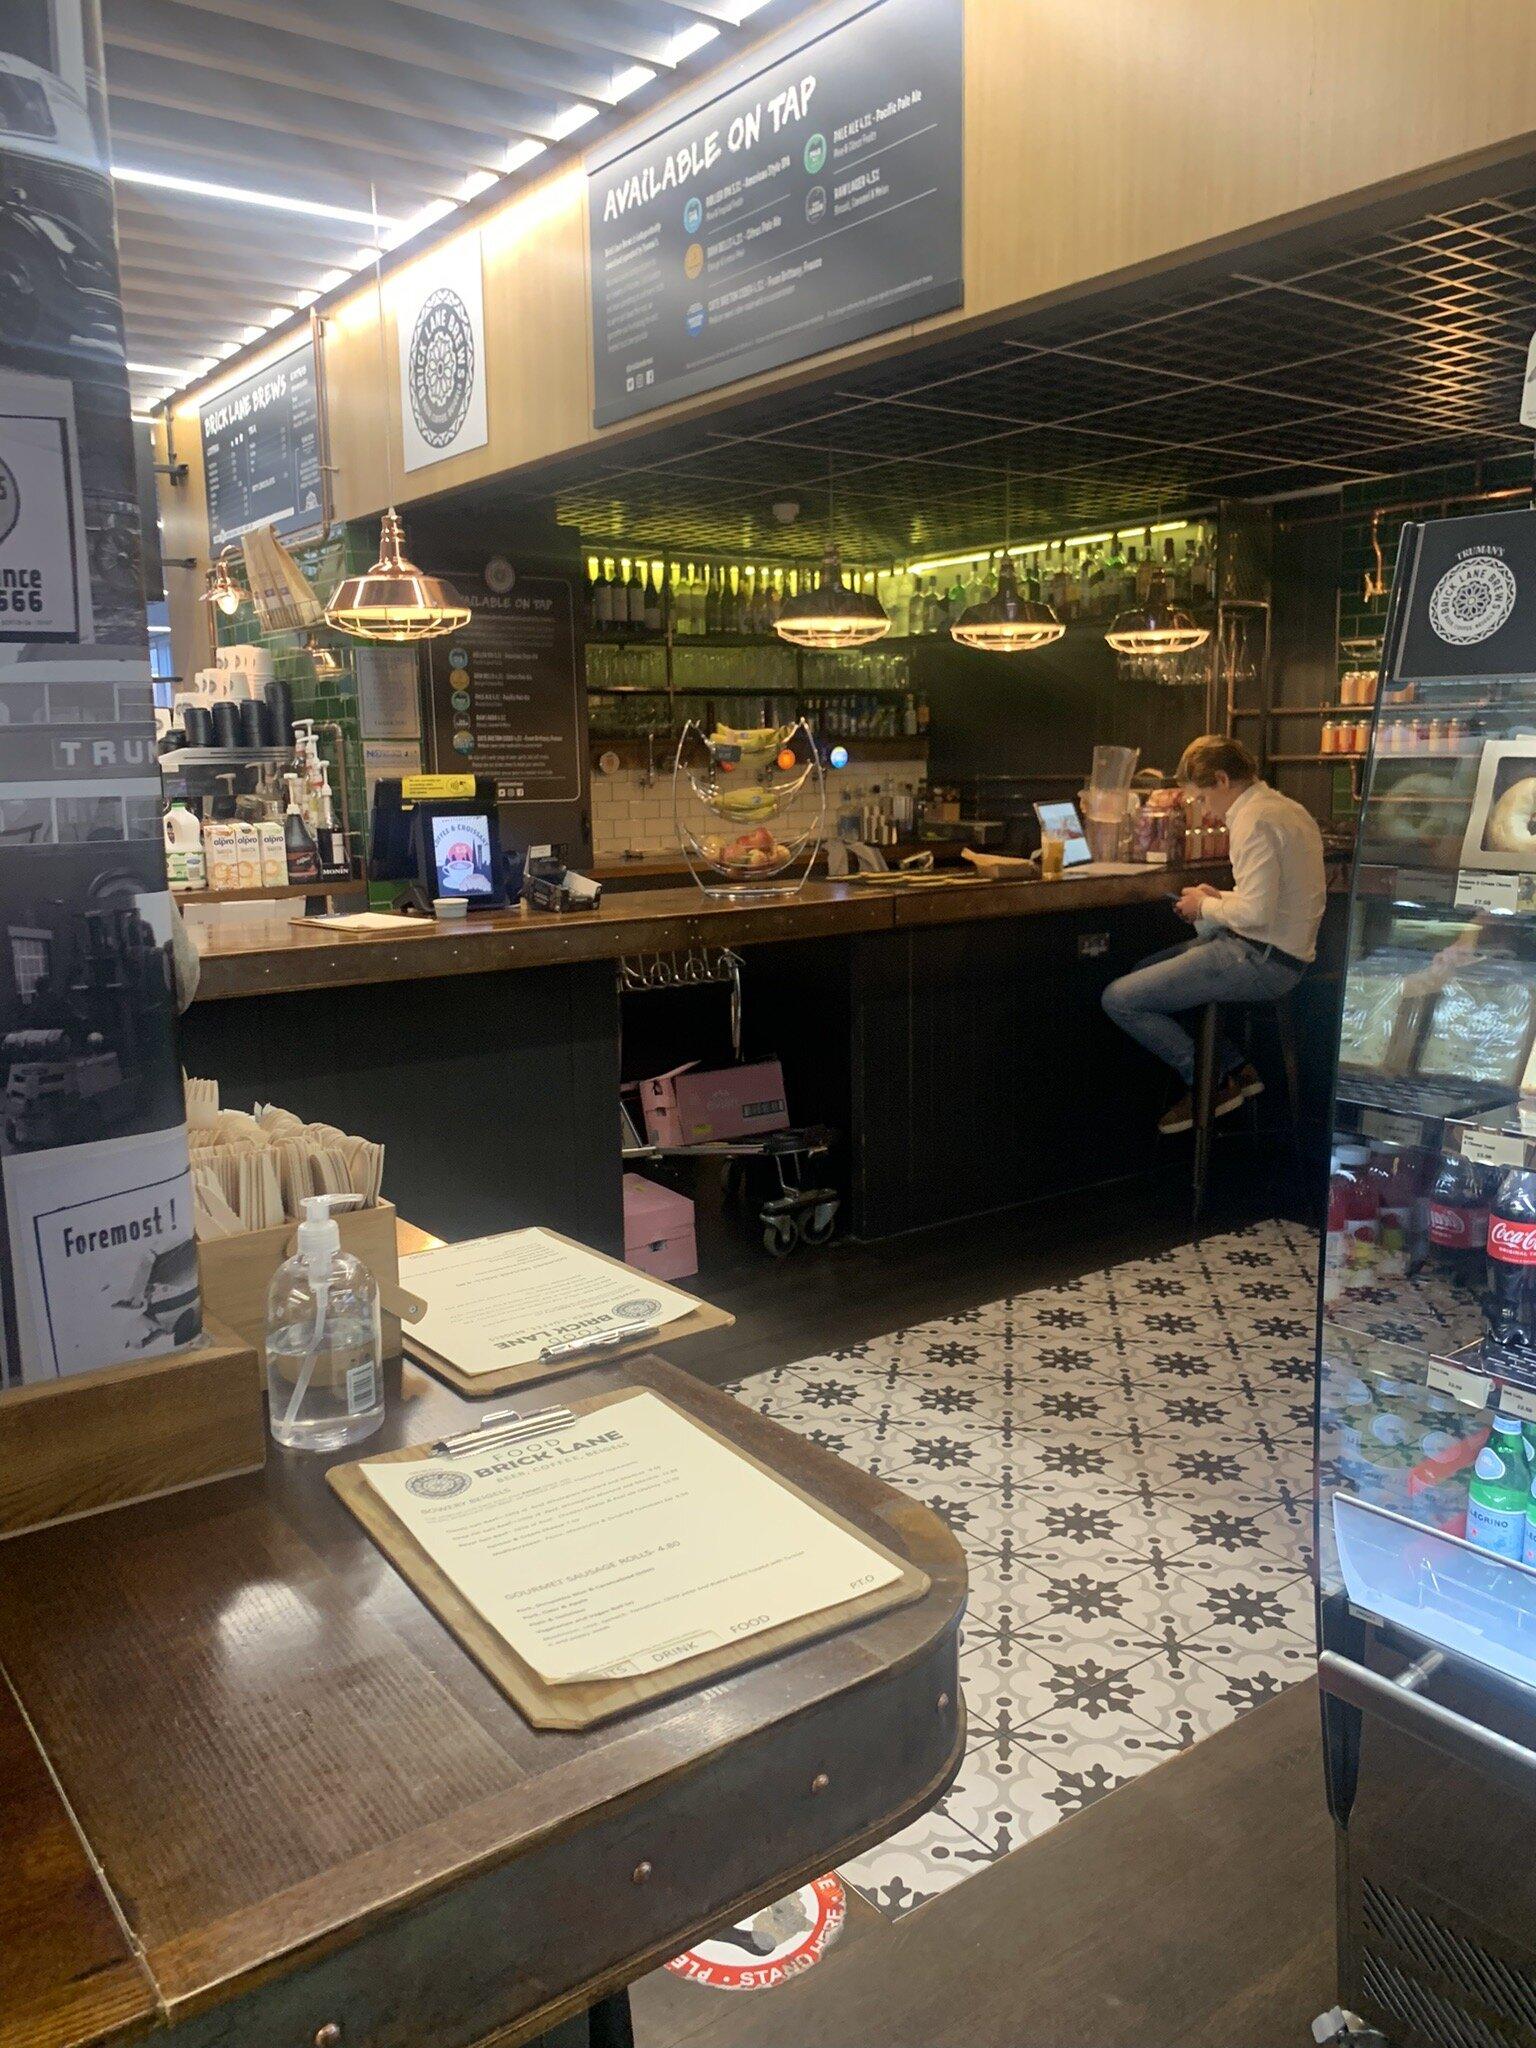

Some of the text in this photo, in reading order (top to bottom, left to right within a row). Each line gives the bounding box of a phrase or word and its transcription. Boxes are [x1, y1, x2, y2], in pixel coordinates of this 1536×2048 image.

[603, 130, 722, 223] AVAILABLE
[727, 105, 761, 154] ON
[768, 76, 817, 134] TAP
[415, 309, 466, 400] BRICK LANE BREWS
[203, 405, 228, 438] BRICK
[228, 391, 252, 423] LANE
[251, 374, 287, 412] BREWS
[1441, 569, 1504, 615] BRICK LANE BREWS
[213, 836, 235, 847] alpro
[237, 835, 258, 846] alpro
[263, 834, 284, 845] alpro
[493, 1313, 613, 1350] BRICK LANE
[473, 1451, 553, 1478] BRICK
[555, 1430, 624, 1454] LANE
[493, 1438, 560, 1461] FOOD
[504, 1577, 563, 1600] GOURMET
[566, 1562, 617, 1582] SAUSAGE
[730, 1614, 771, 1634] FOOD
[652, 1640, 698, 1663] DRINK
[739, 1953, 815, 1987] STAND
